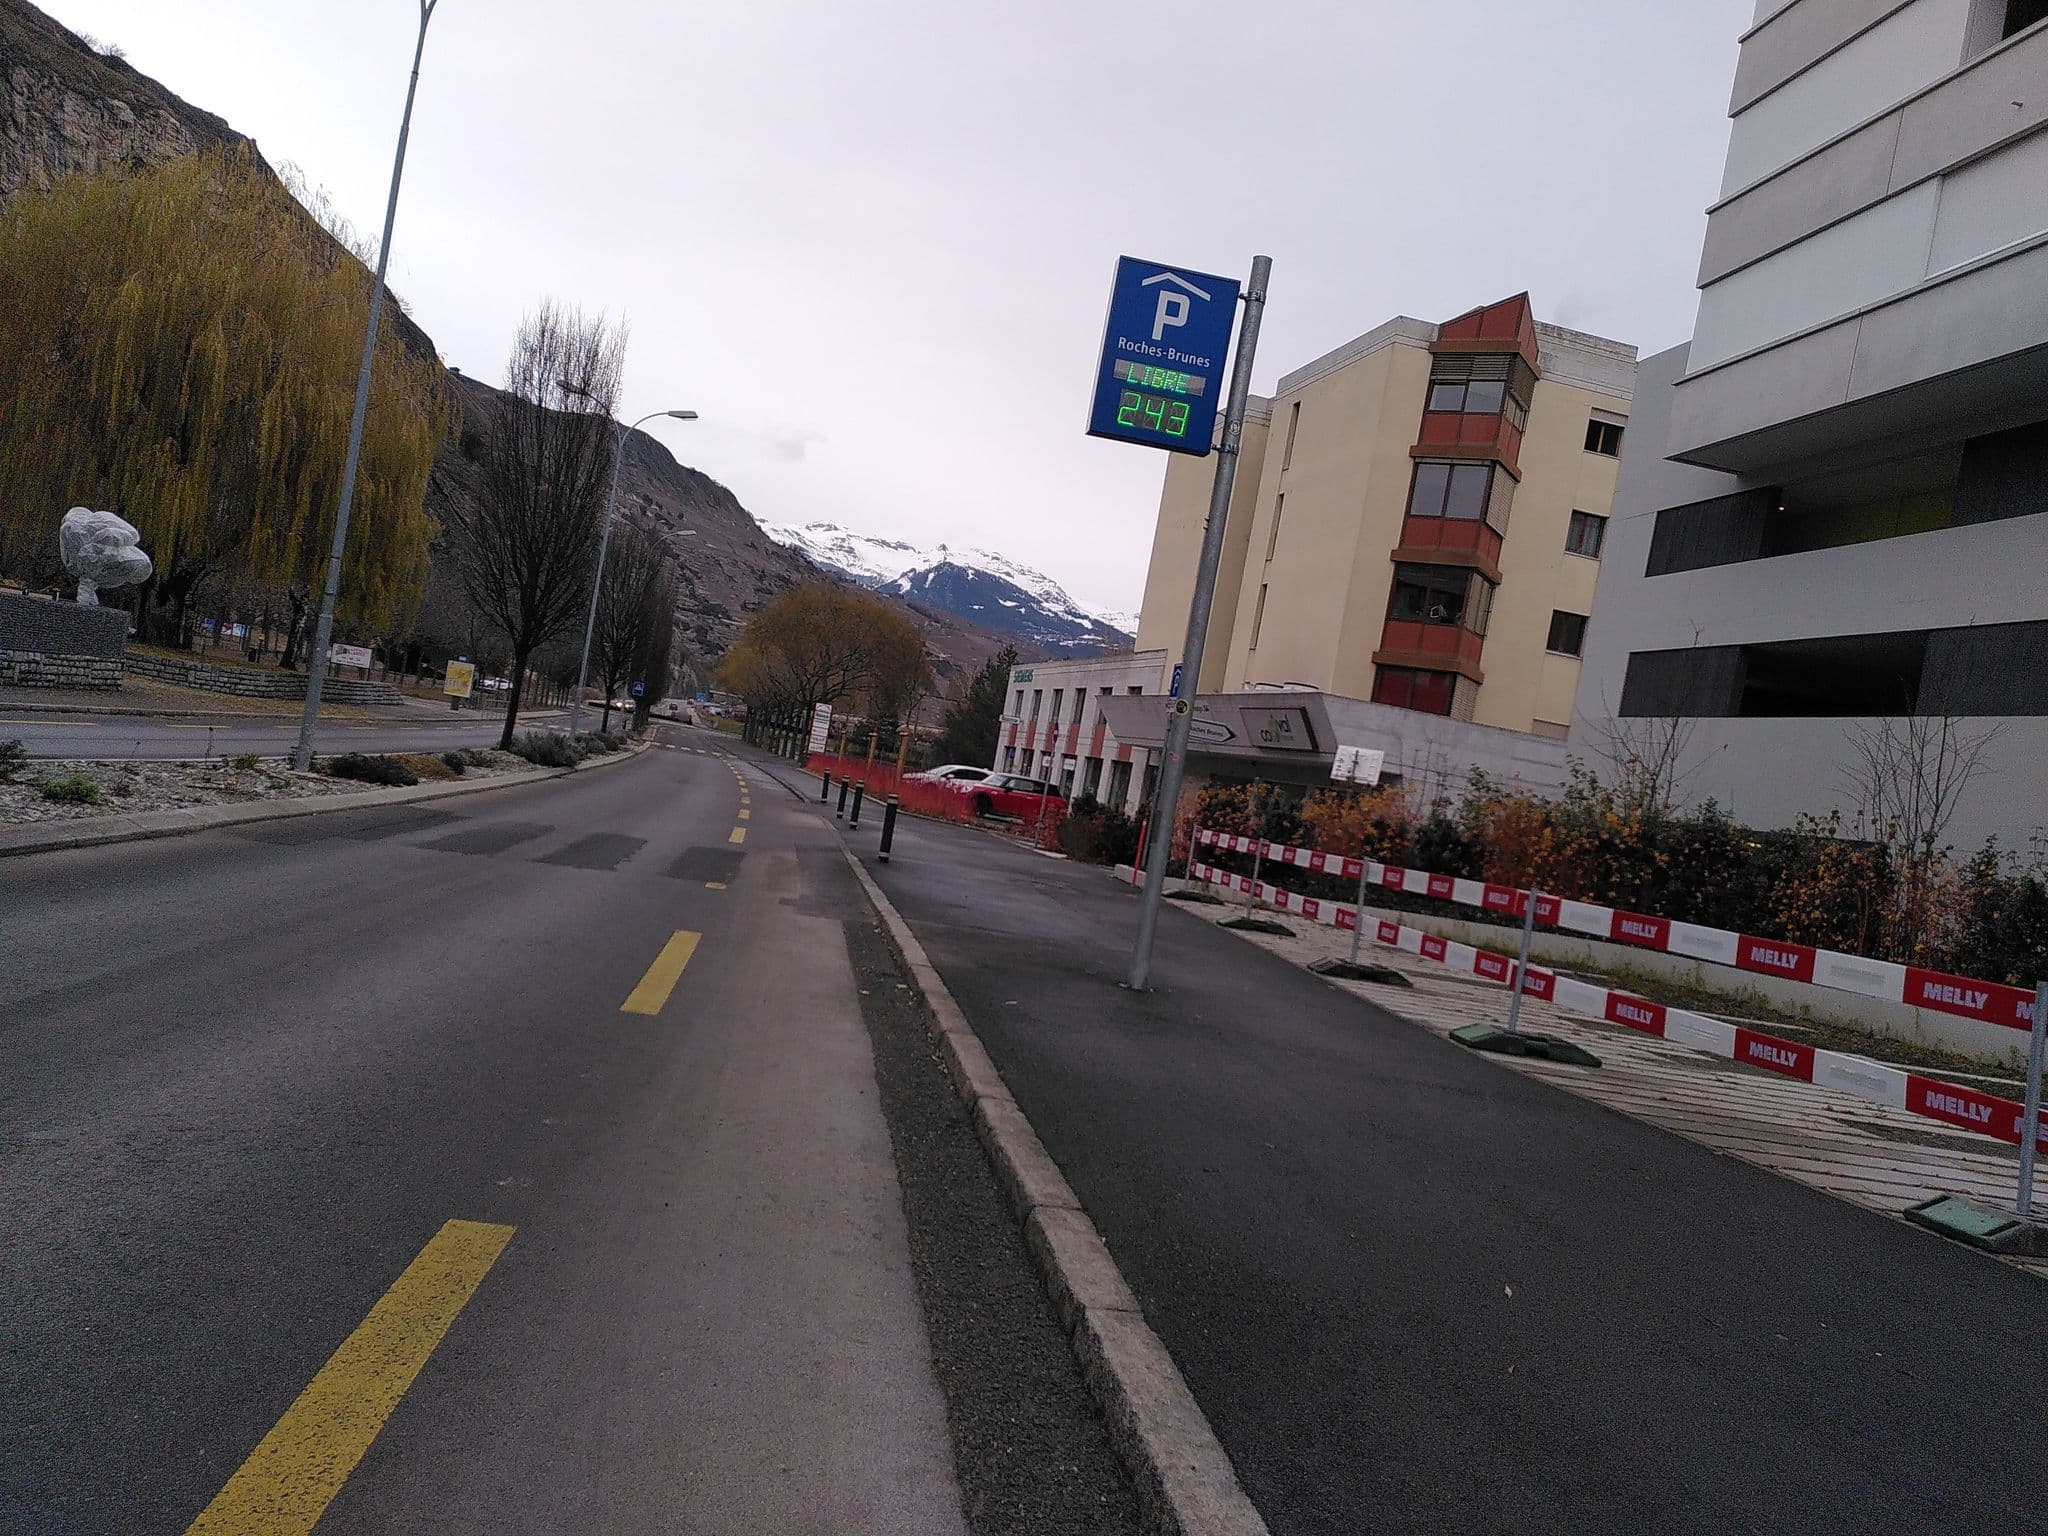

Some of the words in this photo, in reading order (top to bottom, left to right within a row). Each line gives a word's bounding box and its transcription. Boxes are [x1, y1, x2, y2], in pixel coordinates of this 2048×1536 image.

[1151, 289, 1190, 341] P
[1117, 337, 1211, 368] Roches-Brunes
[1126, 362, 1191, 394] LIBRE
[1116, 391, 1191, 437] 243
[1620, 919, 1659, 939] MELLY
[1750, 946, 1800, 970] MELLY
[1923, 982, 1990, 1010] MELLY
[1615, 1002, 1654, 1025] MELLY
[1749, 1041, 1798, 1068] MELLY
[1925, 1090, 1993, 1124] MELLY
